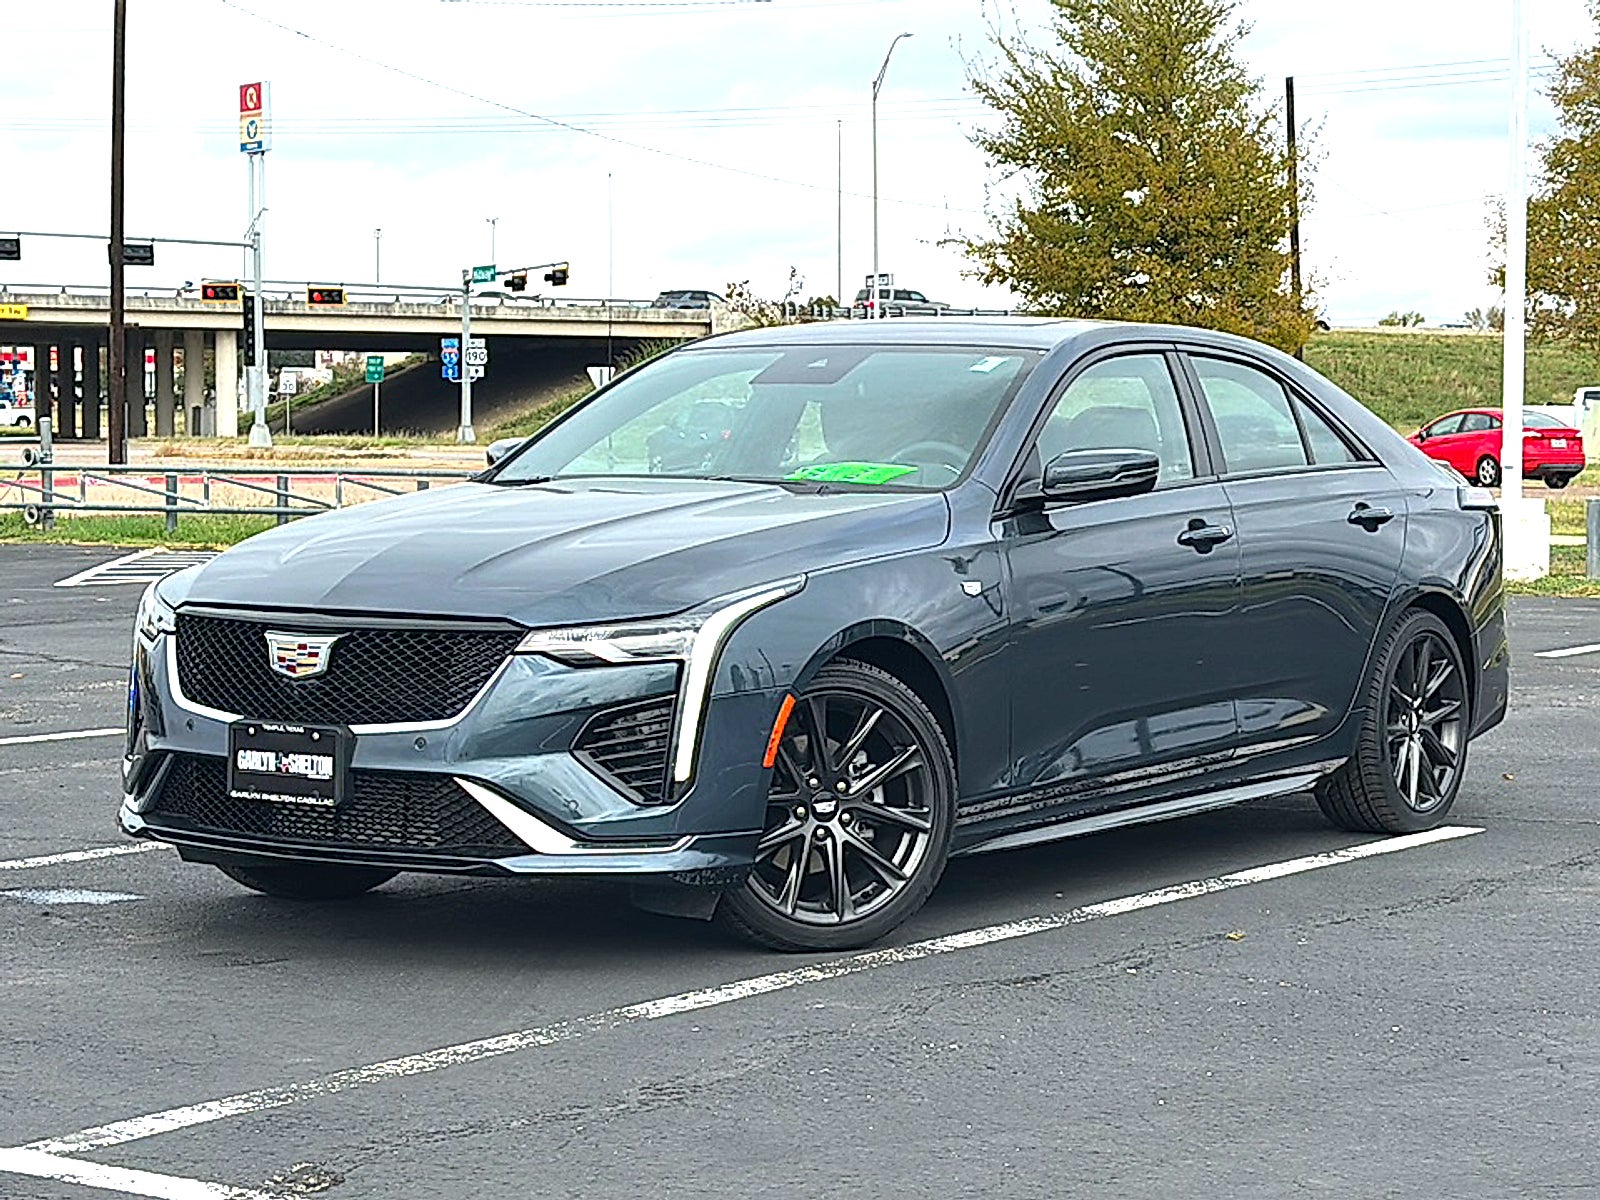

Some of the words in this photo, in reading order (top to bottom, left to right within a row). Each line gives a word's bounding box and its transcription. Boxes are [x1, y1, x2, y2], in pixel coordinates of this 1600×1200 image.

[467, 351, 485, 361] 190
[289, 754, 333, 776] SHELTON
[297, 796, 334, 806] CADILLAC
